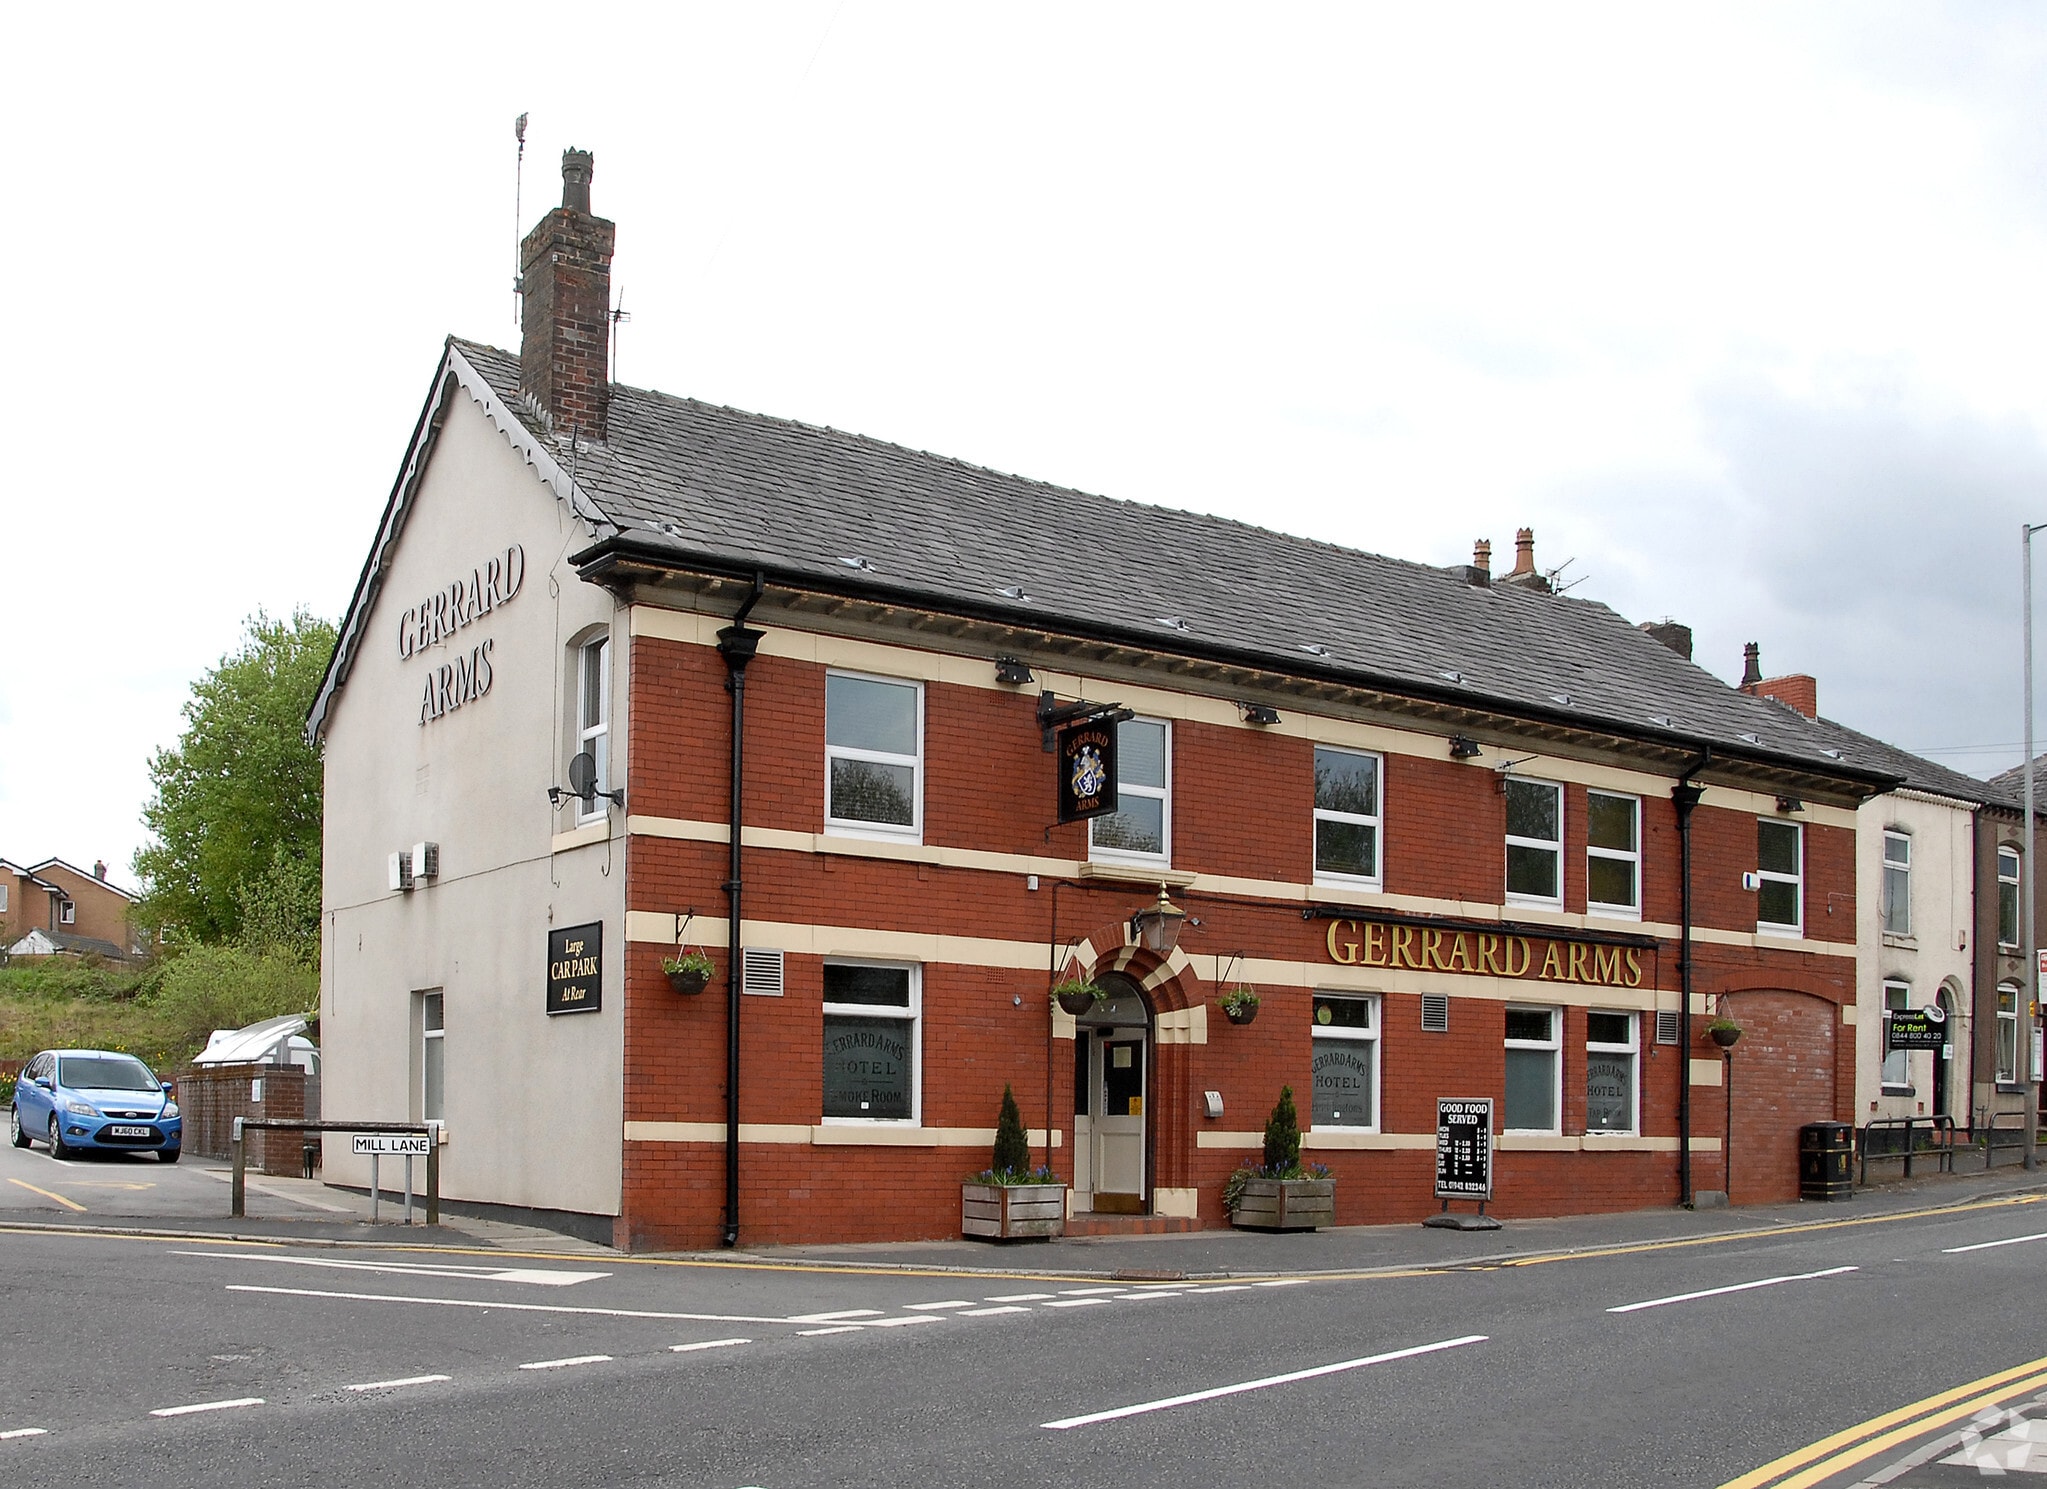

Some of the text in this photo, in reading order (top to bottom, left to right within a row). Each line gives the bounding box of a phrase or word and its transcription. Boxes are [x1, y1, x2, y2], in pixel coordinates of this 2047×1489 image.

[397, 543, 525, 661] GERRARD
[417, 638, 494, 727] ARMS
[1066, 731, 1109, 757] GERRARD
[1075, 795, 1100, 812] ARMS
[565, 939, 584, 957] Large
[1326, 918, 1643, 987] GERRARD ARMS
[551, 956, 598, 980] CAR PARK
[1892, 1023, 1927, 1032] For Rent
[1315, 1075, 1361, 1089] HOTEL
[1587, 1084, 1623, 1097] HOTEL
[1440, 1103, 1488, 1114] GOOD FOOD
[1447, 1114, 1478, 1124] SERVED
[355, 1139, 428, 1151] MILL LANE
[1437, 1180, 1448, 1189] TEL
